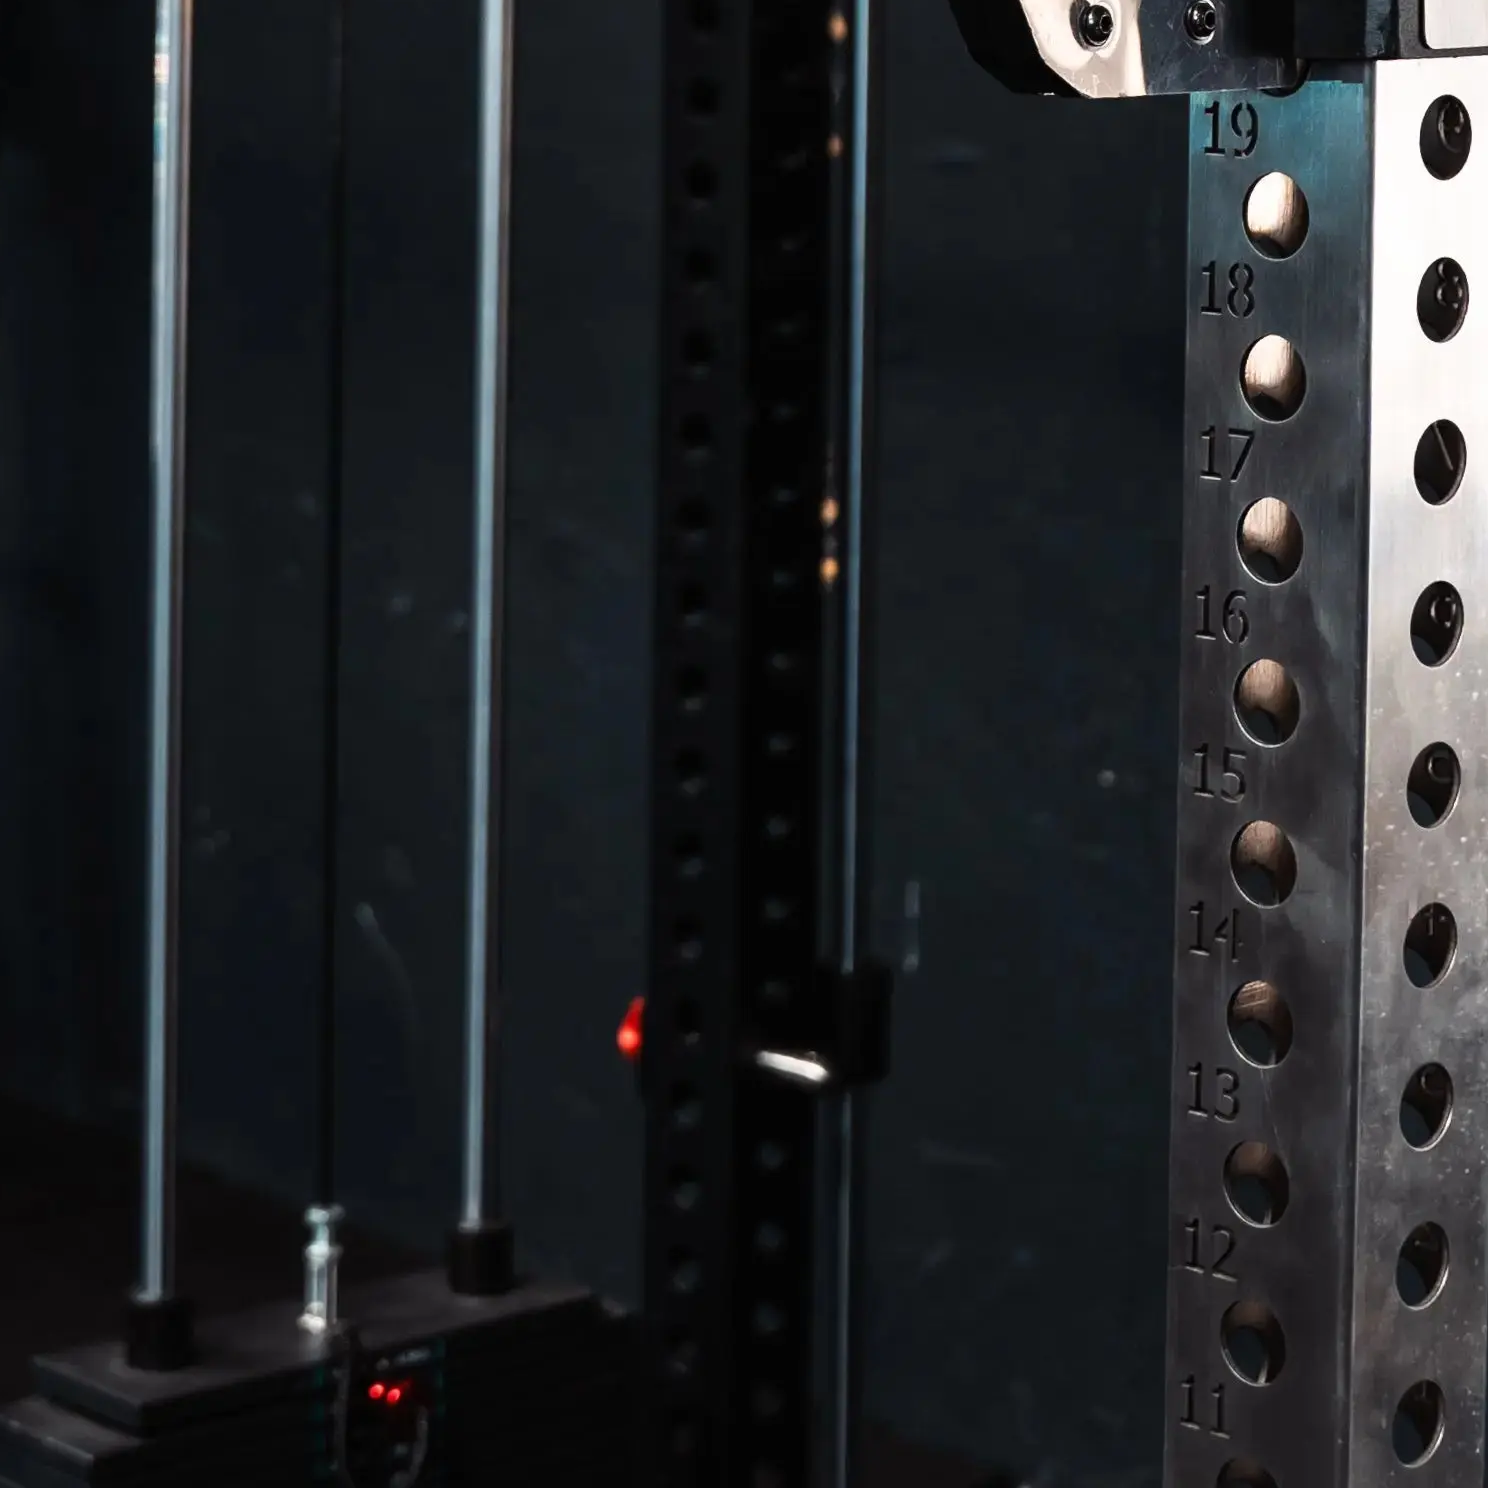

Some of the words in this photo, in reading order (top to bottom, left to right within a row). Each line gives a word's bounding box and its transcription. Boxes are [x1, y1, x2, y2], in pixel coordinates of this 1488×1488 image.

[1203, 98, 1259, 158] 19
[1199, 260, 1257, 319] 18
[1199, 425, 1257, 483] 17
[1194, 584, 1250, 645] 16
[1192, 742, 1248, 804] 15
[1187, 900, 1240, 963] 14
[1186, 1061, 1241, 1124] 13
[1183, 1219, 1238, 1283] 12
[1178, 1375, 1231, 1440] 11
